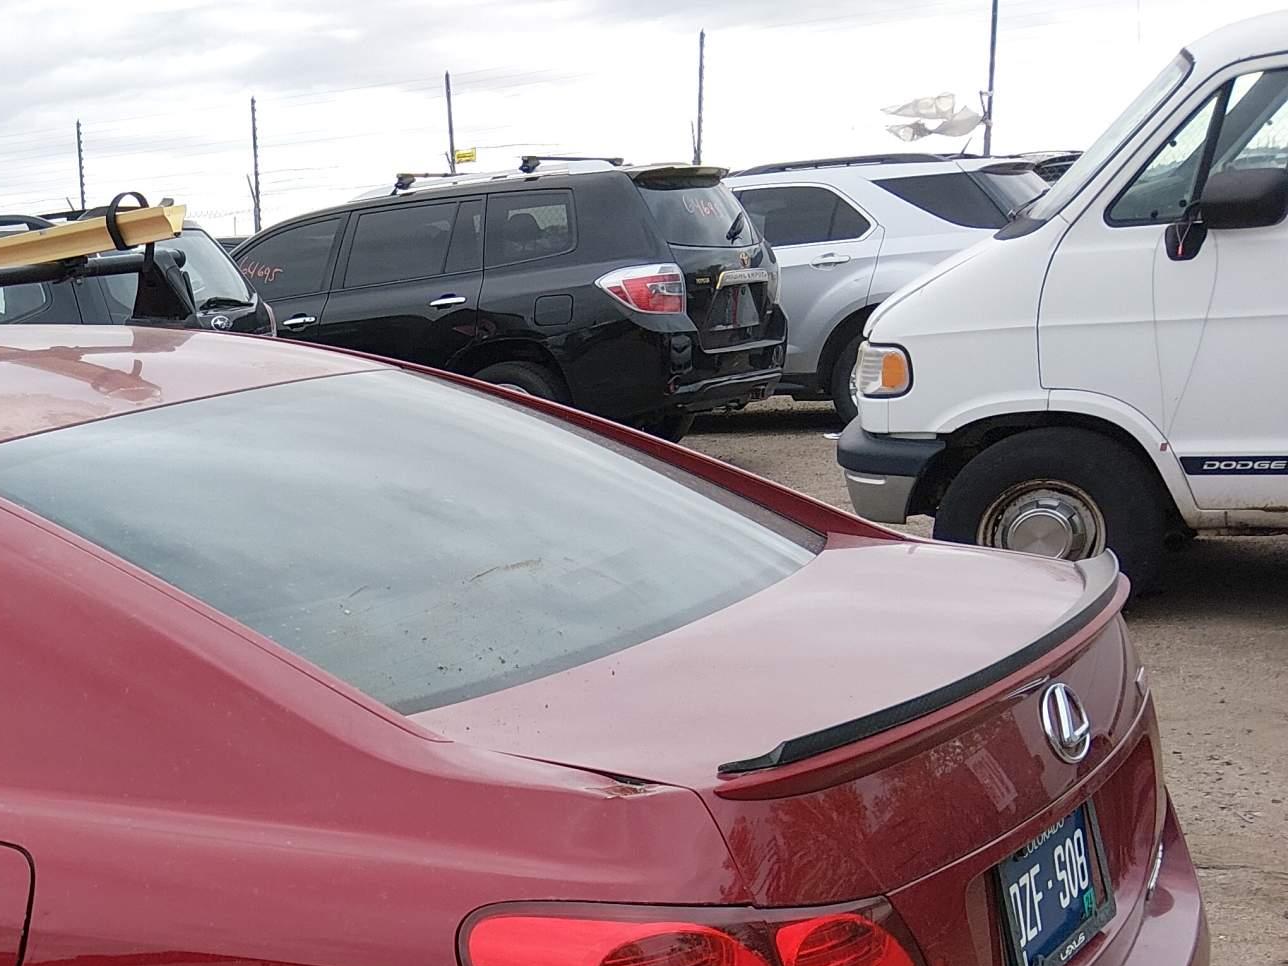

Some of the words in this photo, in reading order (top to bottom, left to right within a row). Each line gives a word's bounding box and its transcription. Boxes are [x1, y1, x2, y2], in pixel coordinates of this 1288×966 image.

[239, 256, 283, 284] 64695
[1202, 461, 1288, 470] DODGE
[1060, 932, 1086, 961] LEXUS
